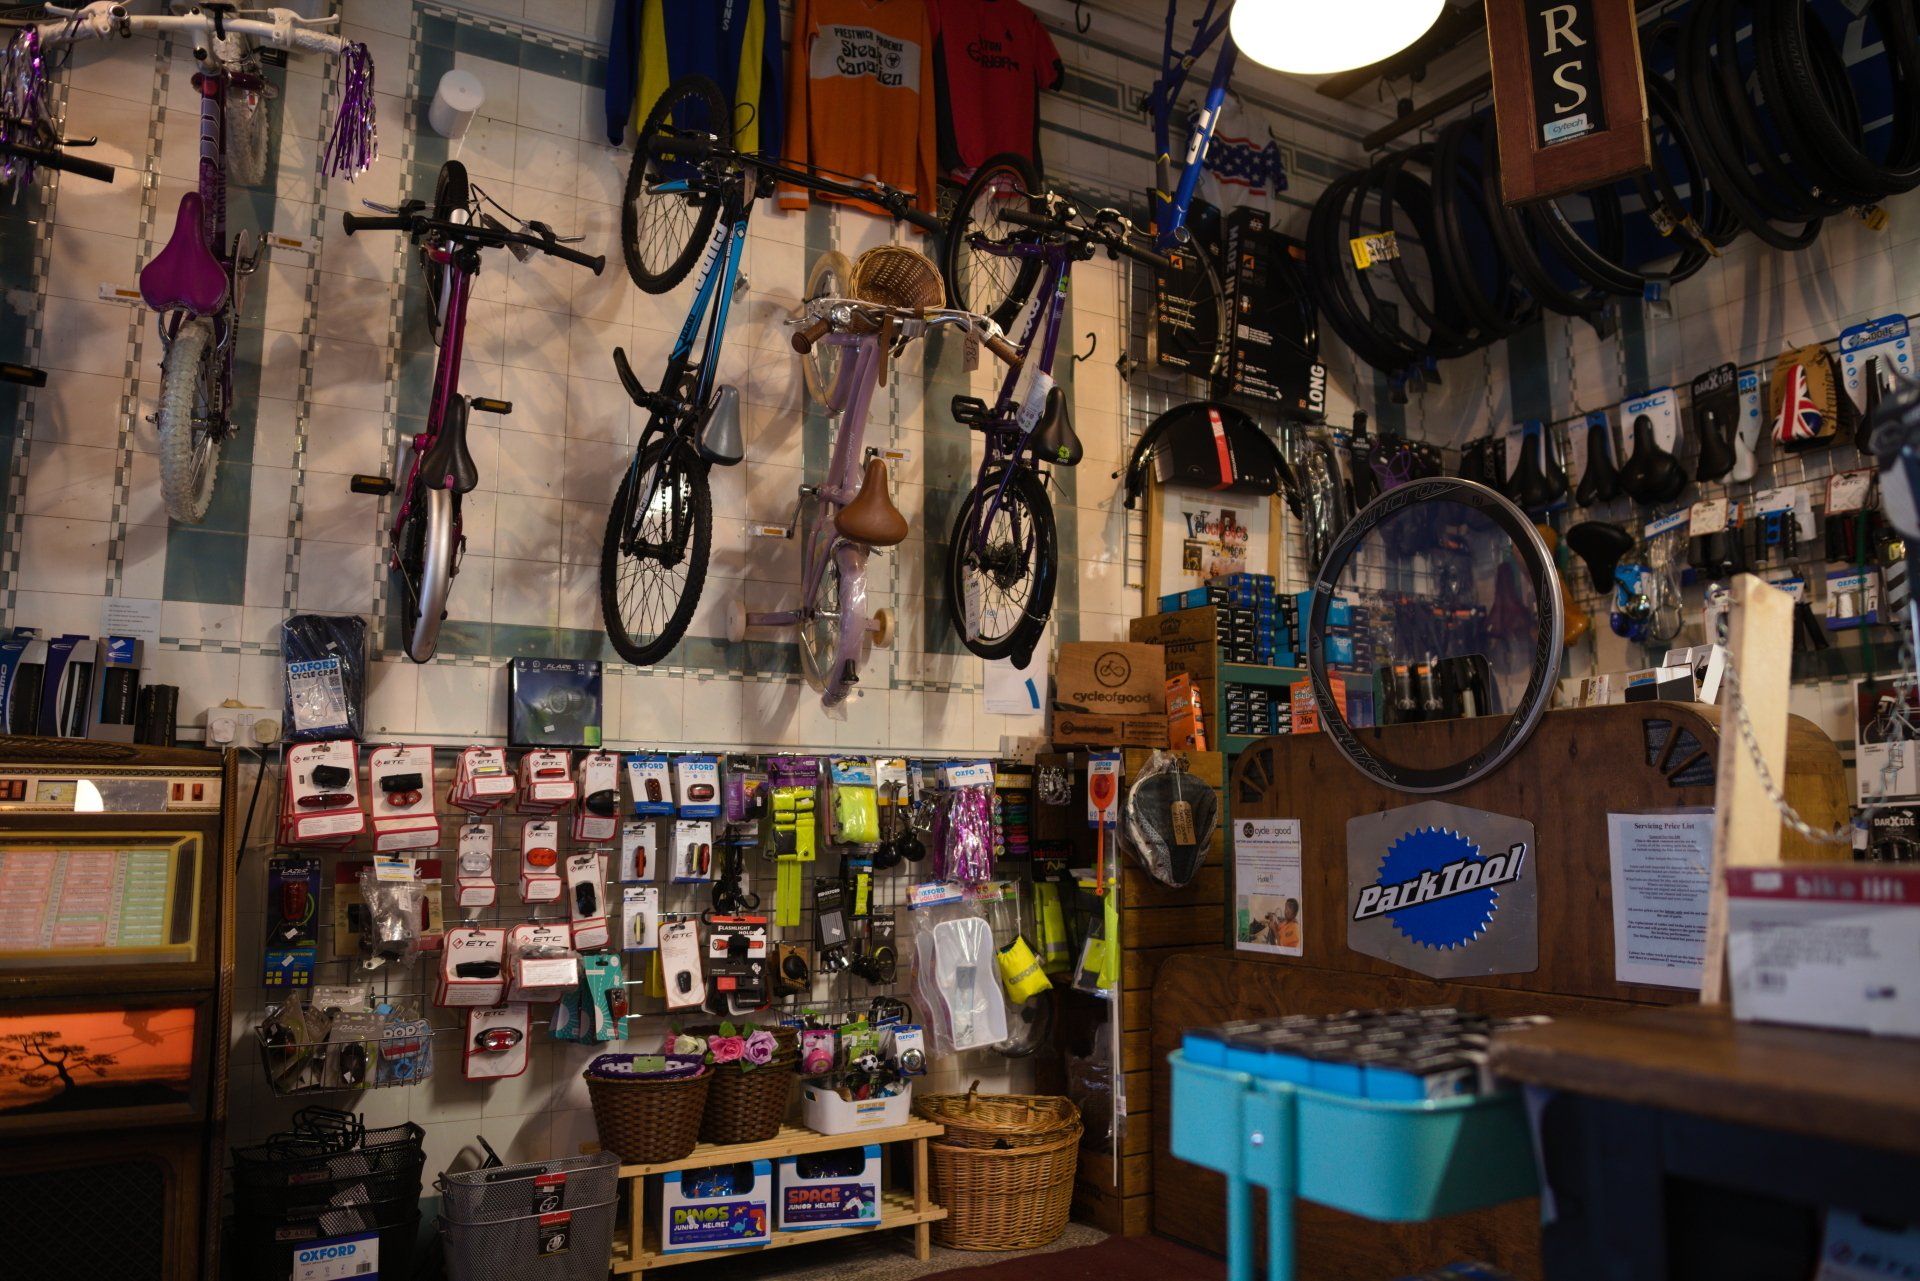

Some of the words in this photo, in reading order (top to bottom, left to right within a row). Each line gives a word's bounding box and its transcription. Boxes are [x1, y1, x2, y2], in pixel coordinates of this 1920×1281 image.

[841, 39, 882, 65] Steak
[836, 55, 902, 86] Canaien
[1552, 118, 1584, 134] cytech
[1226, 225, 1240, 273] MADE
[1308, 364, 1325, 413] LONG
[290, 660, 337, 674] OXFORD
[292, 670, 316, 681] CYCLE
[1073, 691, 1151, 705] cycleofgood
[632, 762, 664, 770] OXFORD
[688, 762, 715, 771] XFORD
[955, 768, 986, 778] OXFOD
[1634, 822, 1662, 831] Servicing
[1664, 822, 1680, 830] Price
[1682, 822, 1694, 830] List
[1353, 842, 1527, 921] ParkTool
[465, 939, 497, 948] ETC
[532, 935, 562, 944] ETC
[788, 1187, 841, 1204] SPACE
[788, 1202, 812, 1211] JUNIOR
[814, 1201, 841, 1210] HELMET
[673, 1223, 700, 1232] JUNIOR
[702, 1220, 730, 1230] HELMET
[298, 1244, 357, 1263] OXFORD
